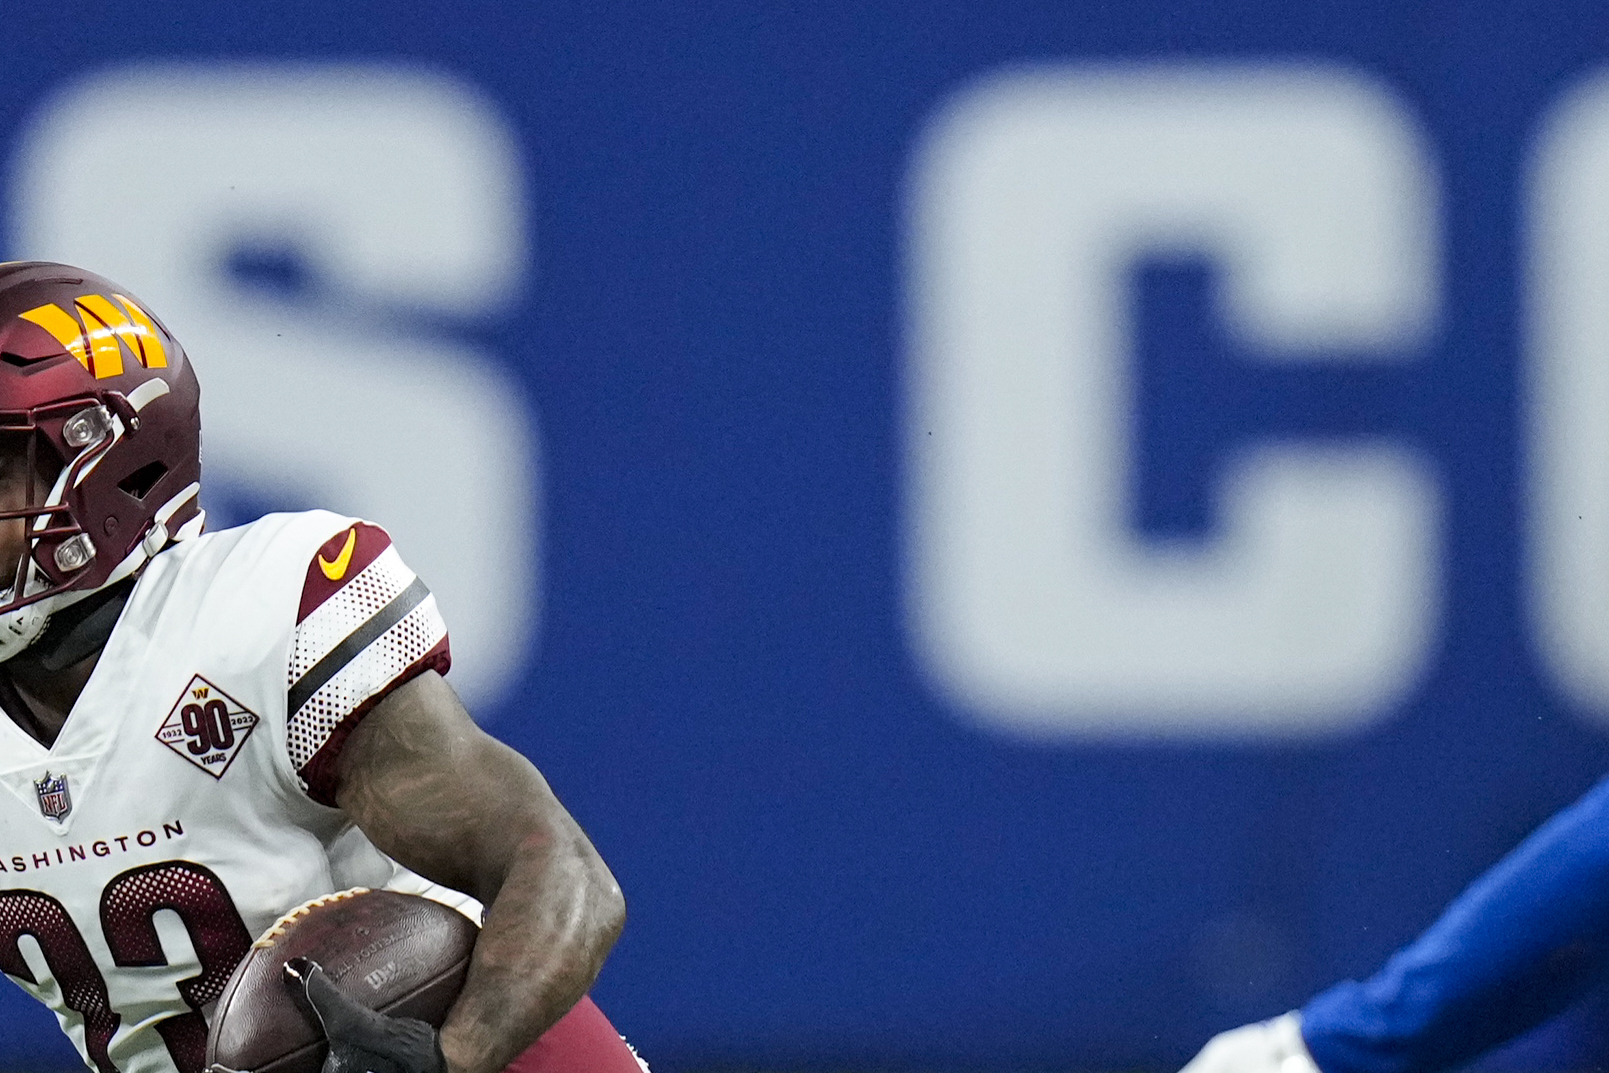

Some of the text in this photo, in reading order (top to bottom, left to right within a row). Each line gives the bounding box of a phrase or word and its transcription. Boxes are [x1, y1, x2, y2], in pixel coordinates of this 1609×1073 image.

[899, 60, 1609, 745] C
[180, 699, 235, 755] 90
[200, 752, 227, 766] YEARS
[41, 792, 68, 815] NFL
